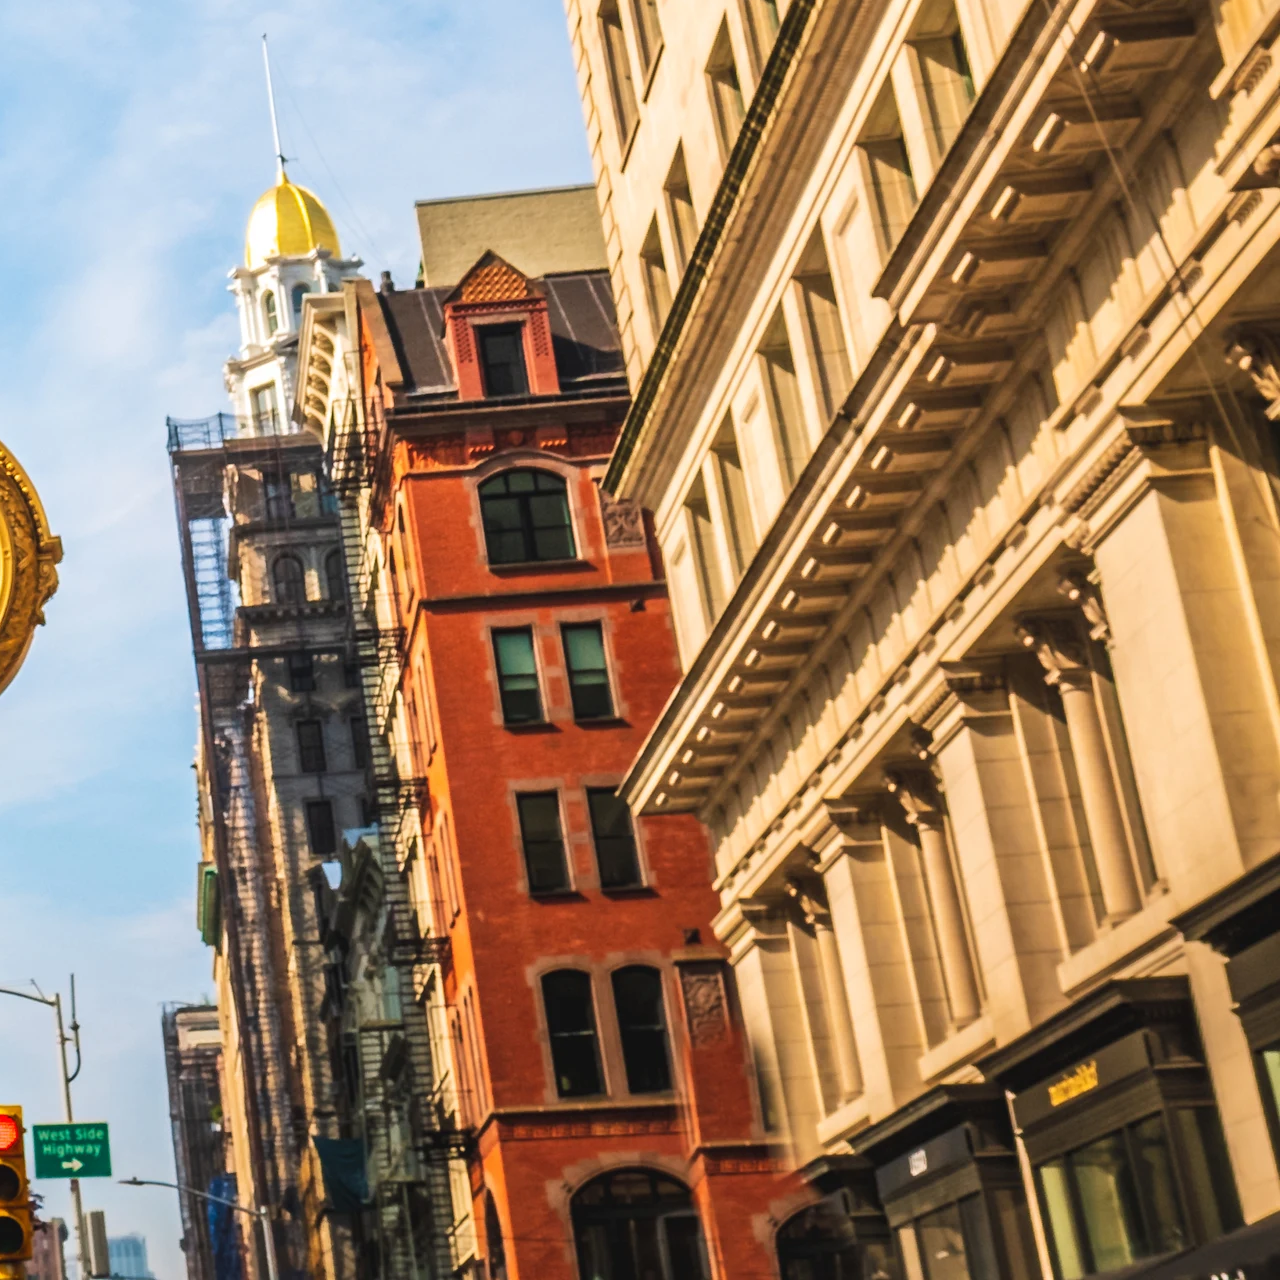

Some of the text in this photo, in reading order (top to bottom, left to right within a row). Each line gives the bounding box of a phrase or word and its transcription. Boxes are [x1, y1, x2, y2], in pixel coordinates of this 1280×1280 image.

[38, 1127, 104, 1140] West Side
[42, 1143, 101, 1158] Highway
